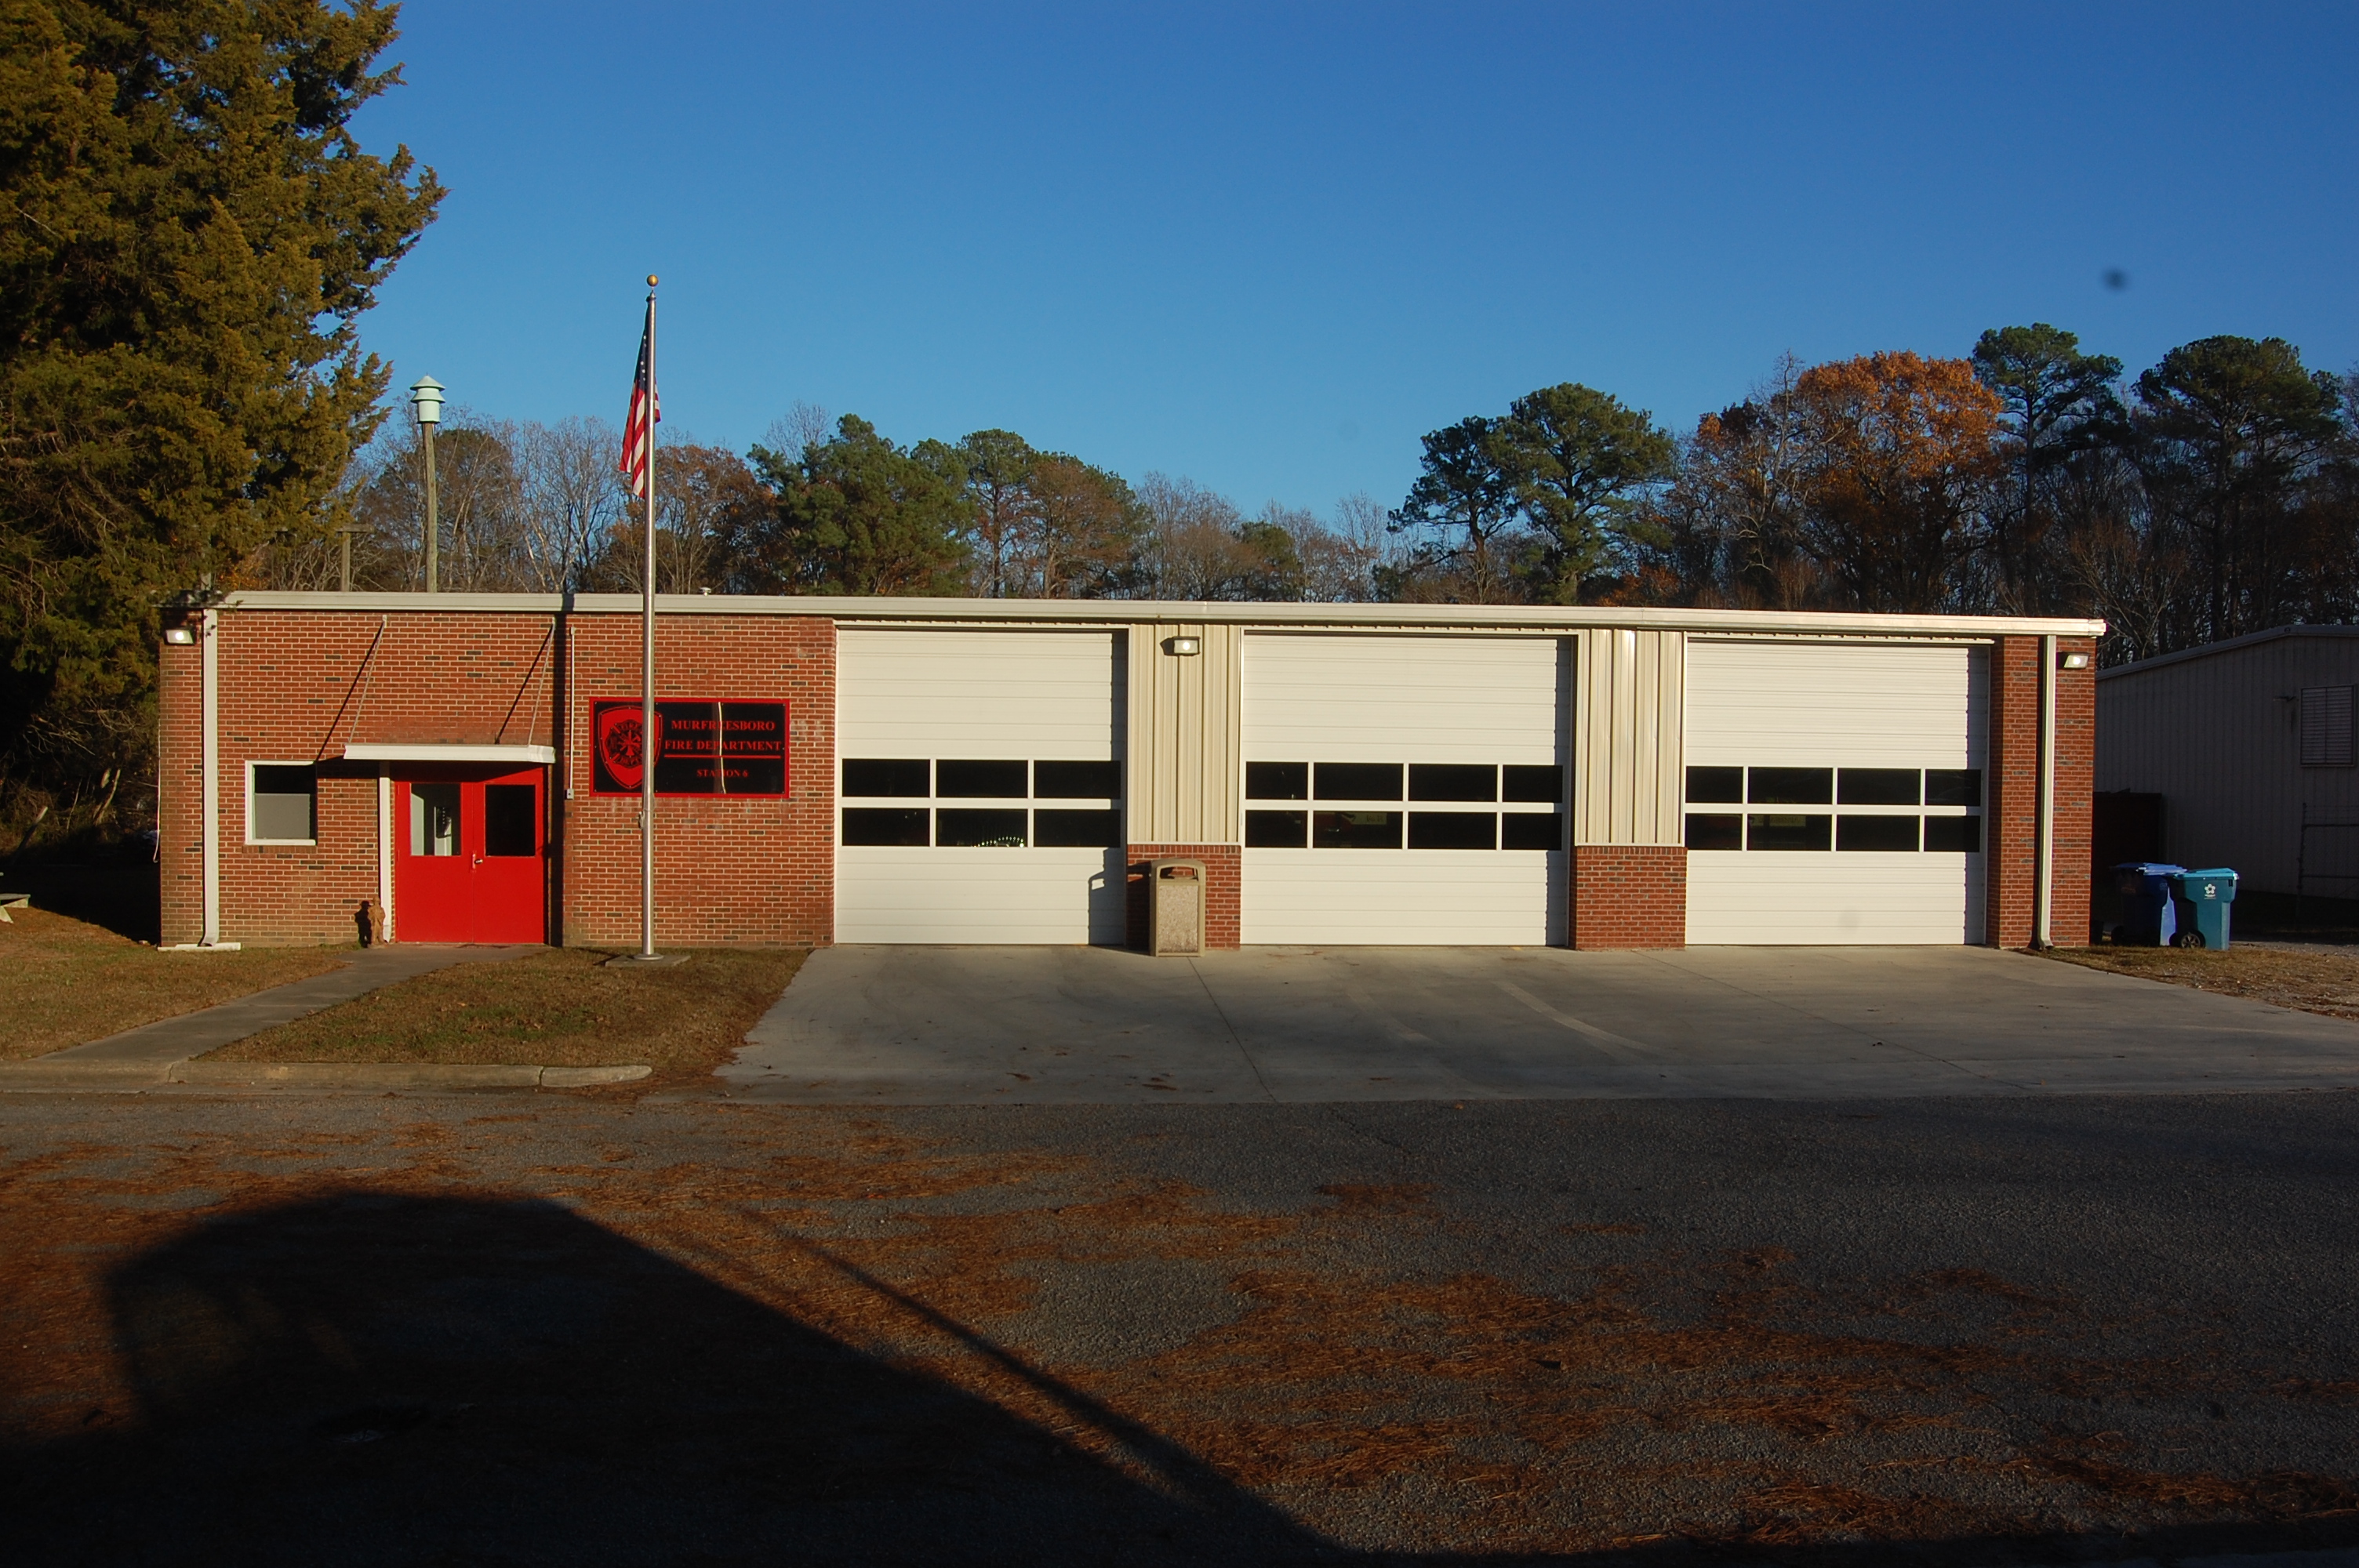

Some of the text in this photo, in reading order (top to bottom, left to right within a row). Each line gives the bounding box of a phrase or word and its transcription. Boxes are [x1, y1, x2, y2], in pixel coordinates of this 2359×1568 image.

[664, 740, 782, 751] FIRE DEPARTMENT
[742, 769, 749, 778] 6
